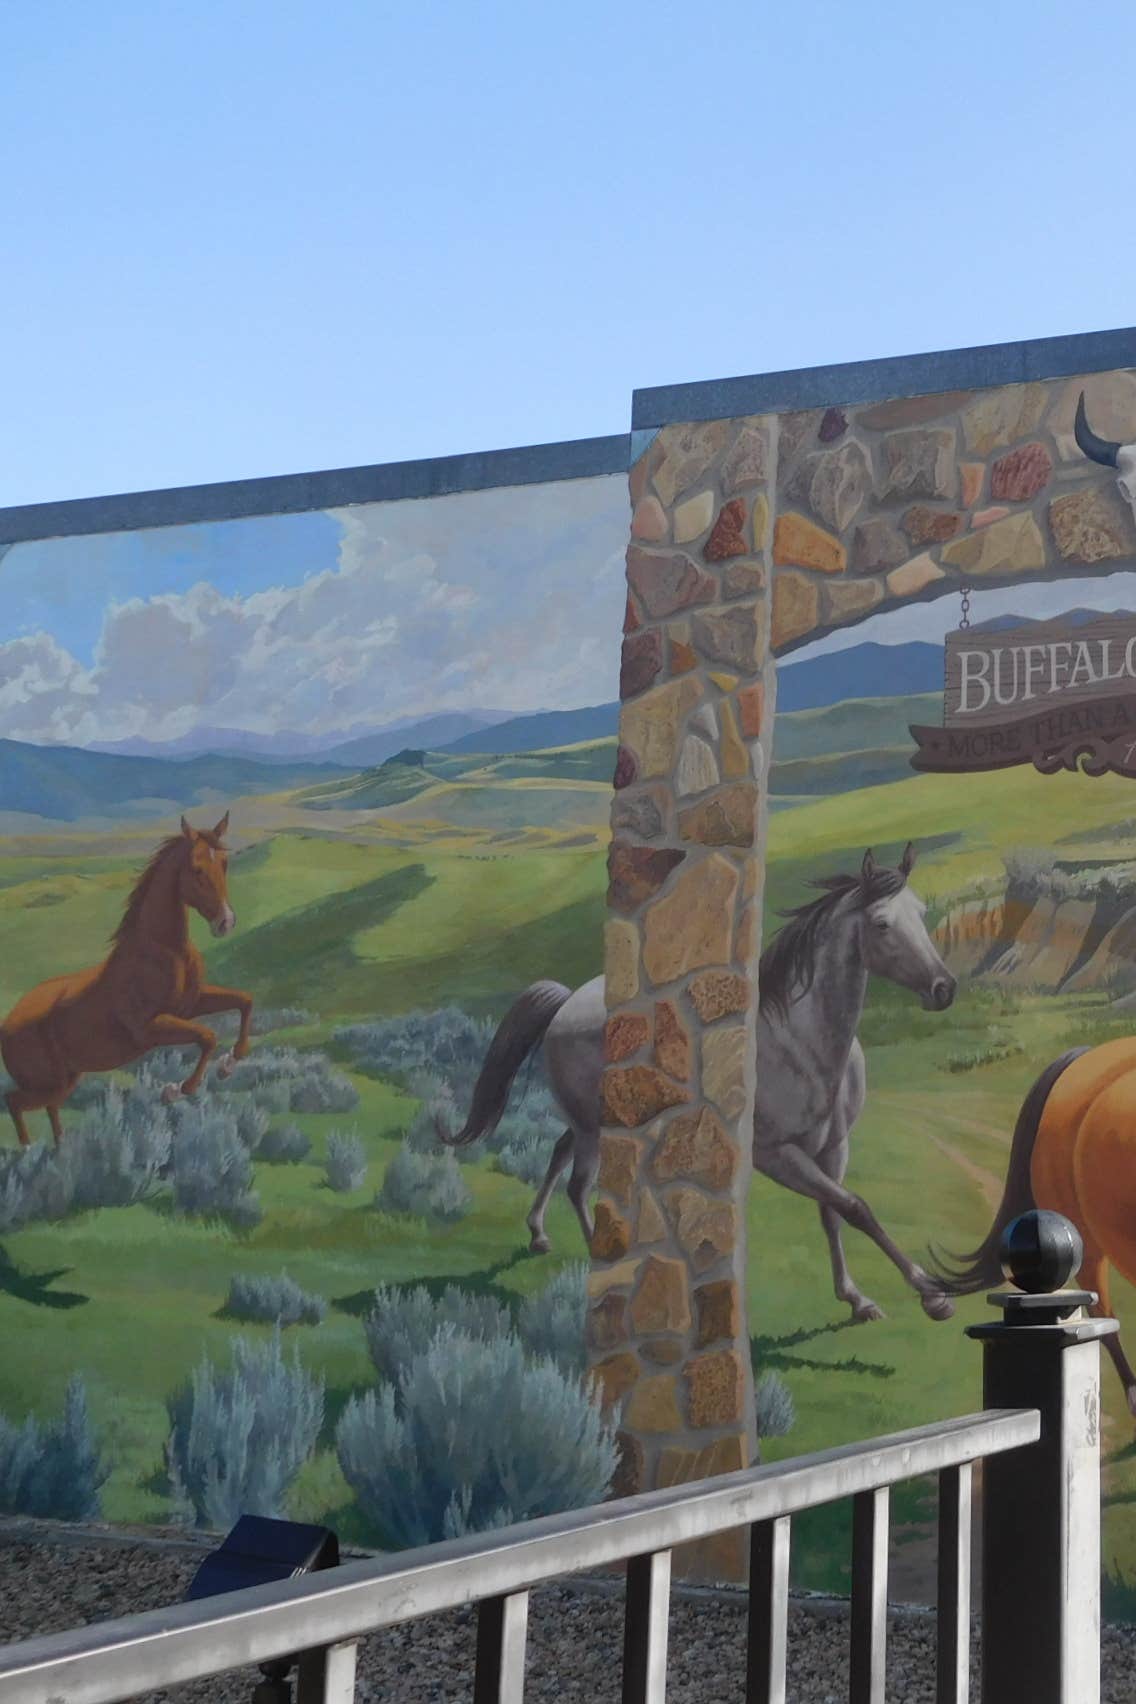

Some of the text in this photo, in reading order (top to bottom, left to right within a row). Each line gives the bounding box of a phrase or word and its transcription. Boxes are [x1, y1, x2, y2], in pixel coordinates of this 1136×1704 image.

[948, 730, 1021, 758] MORE
[1030, 711, 1103, 746] THAN
[1111, 701, 1134, 723] A
